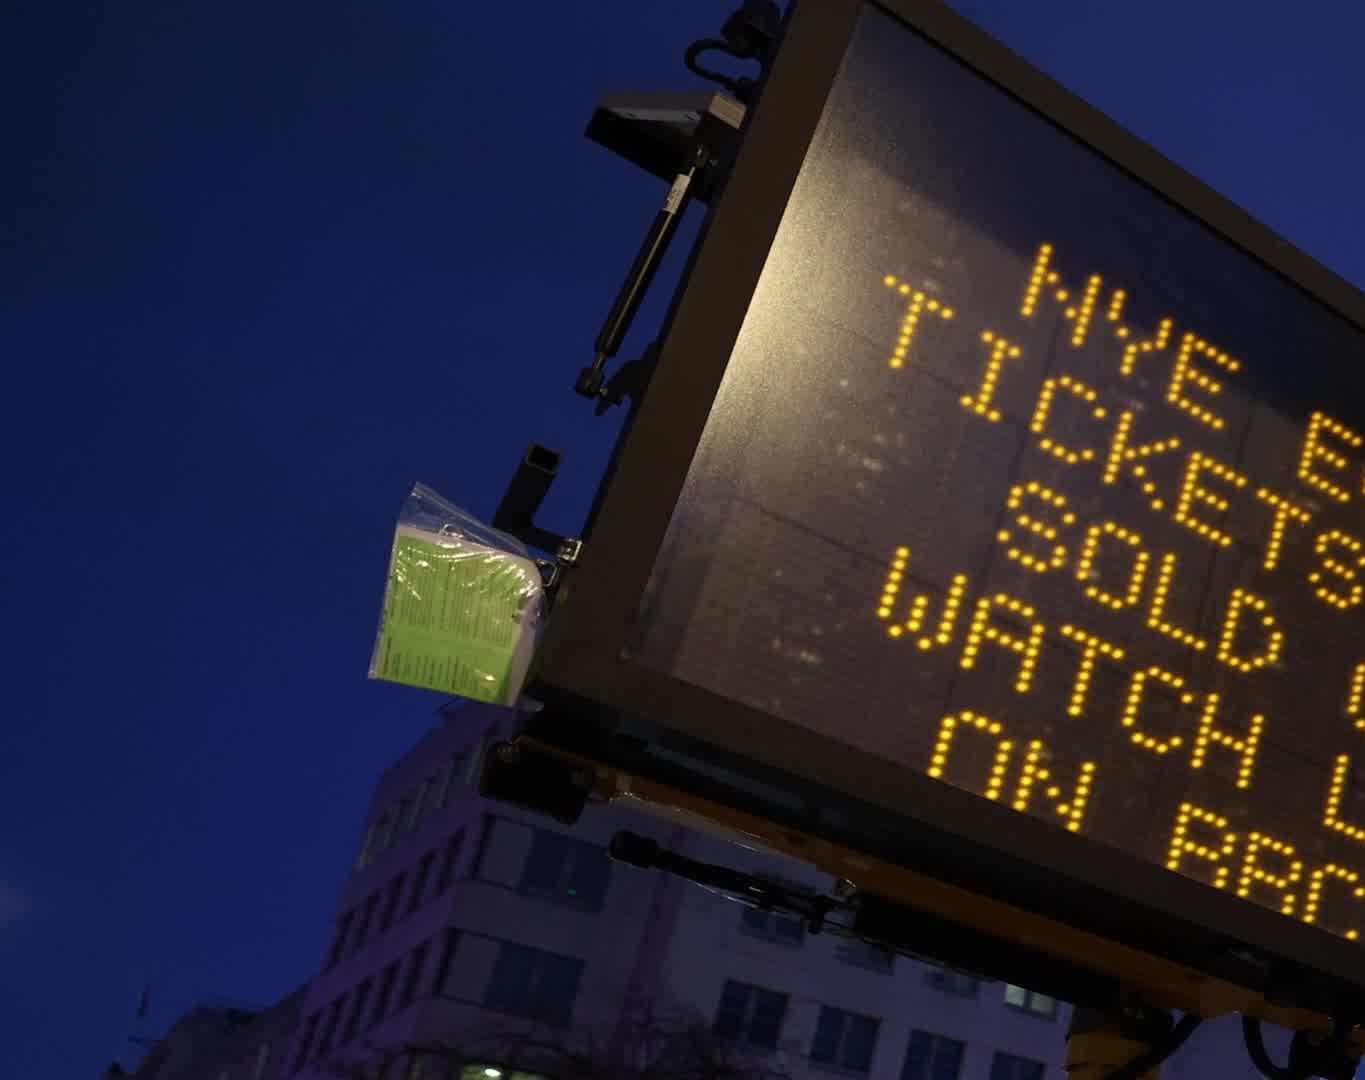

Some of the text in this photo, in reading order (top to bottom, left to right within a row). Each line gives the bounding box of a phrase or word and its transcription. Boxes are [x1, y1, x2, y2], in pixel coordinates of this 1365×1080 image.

[1021, 245, 1239, 428] NYE
[878, 547, 1264, 787] WATCH
[998, 482, 1283, 672] SOLD
[928, 712, 1095, 831] ON
[1167, 804, 1365, 939] BBC
